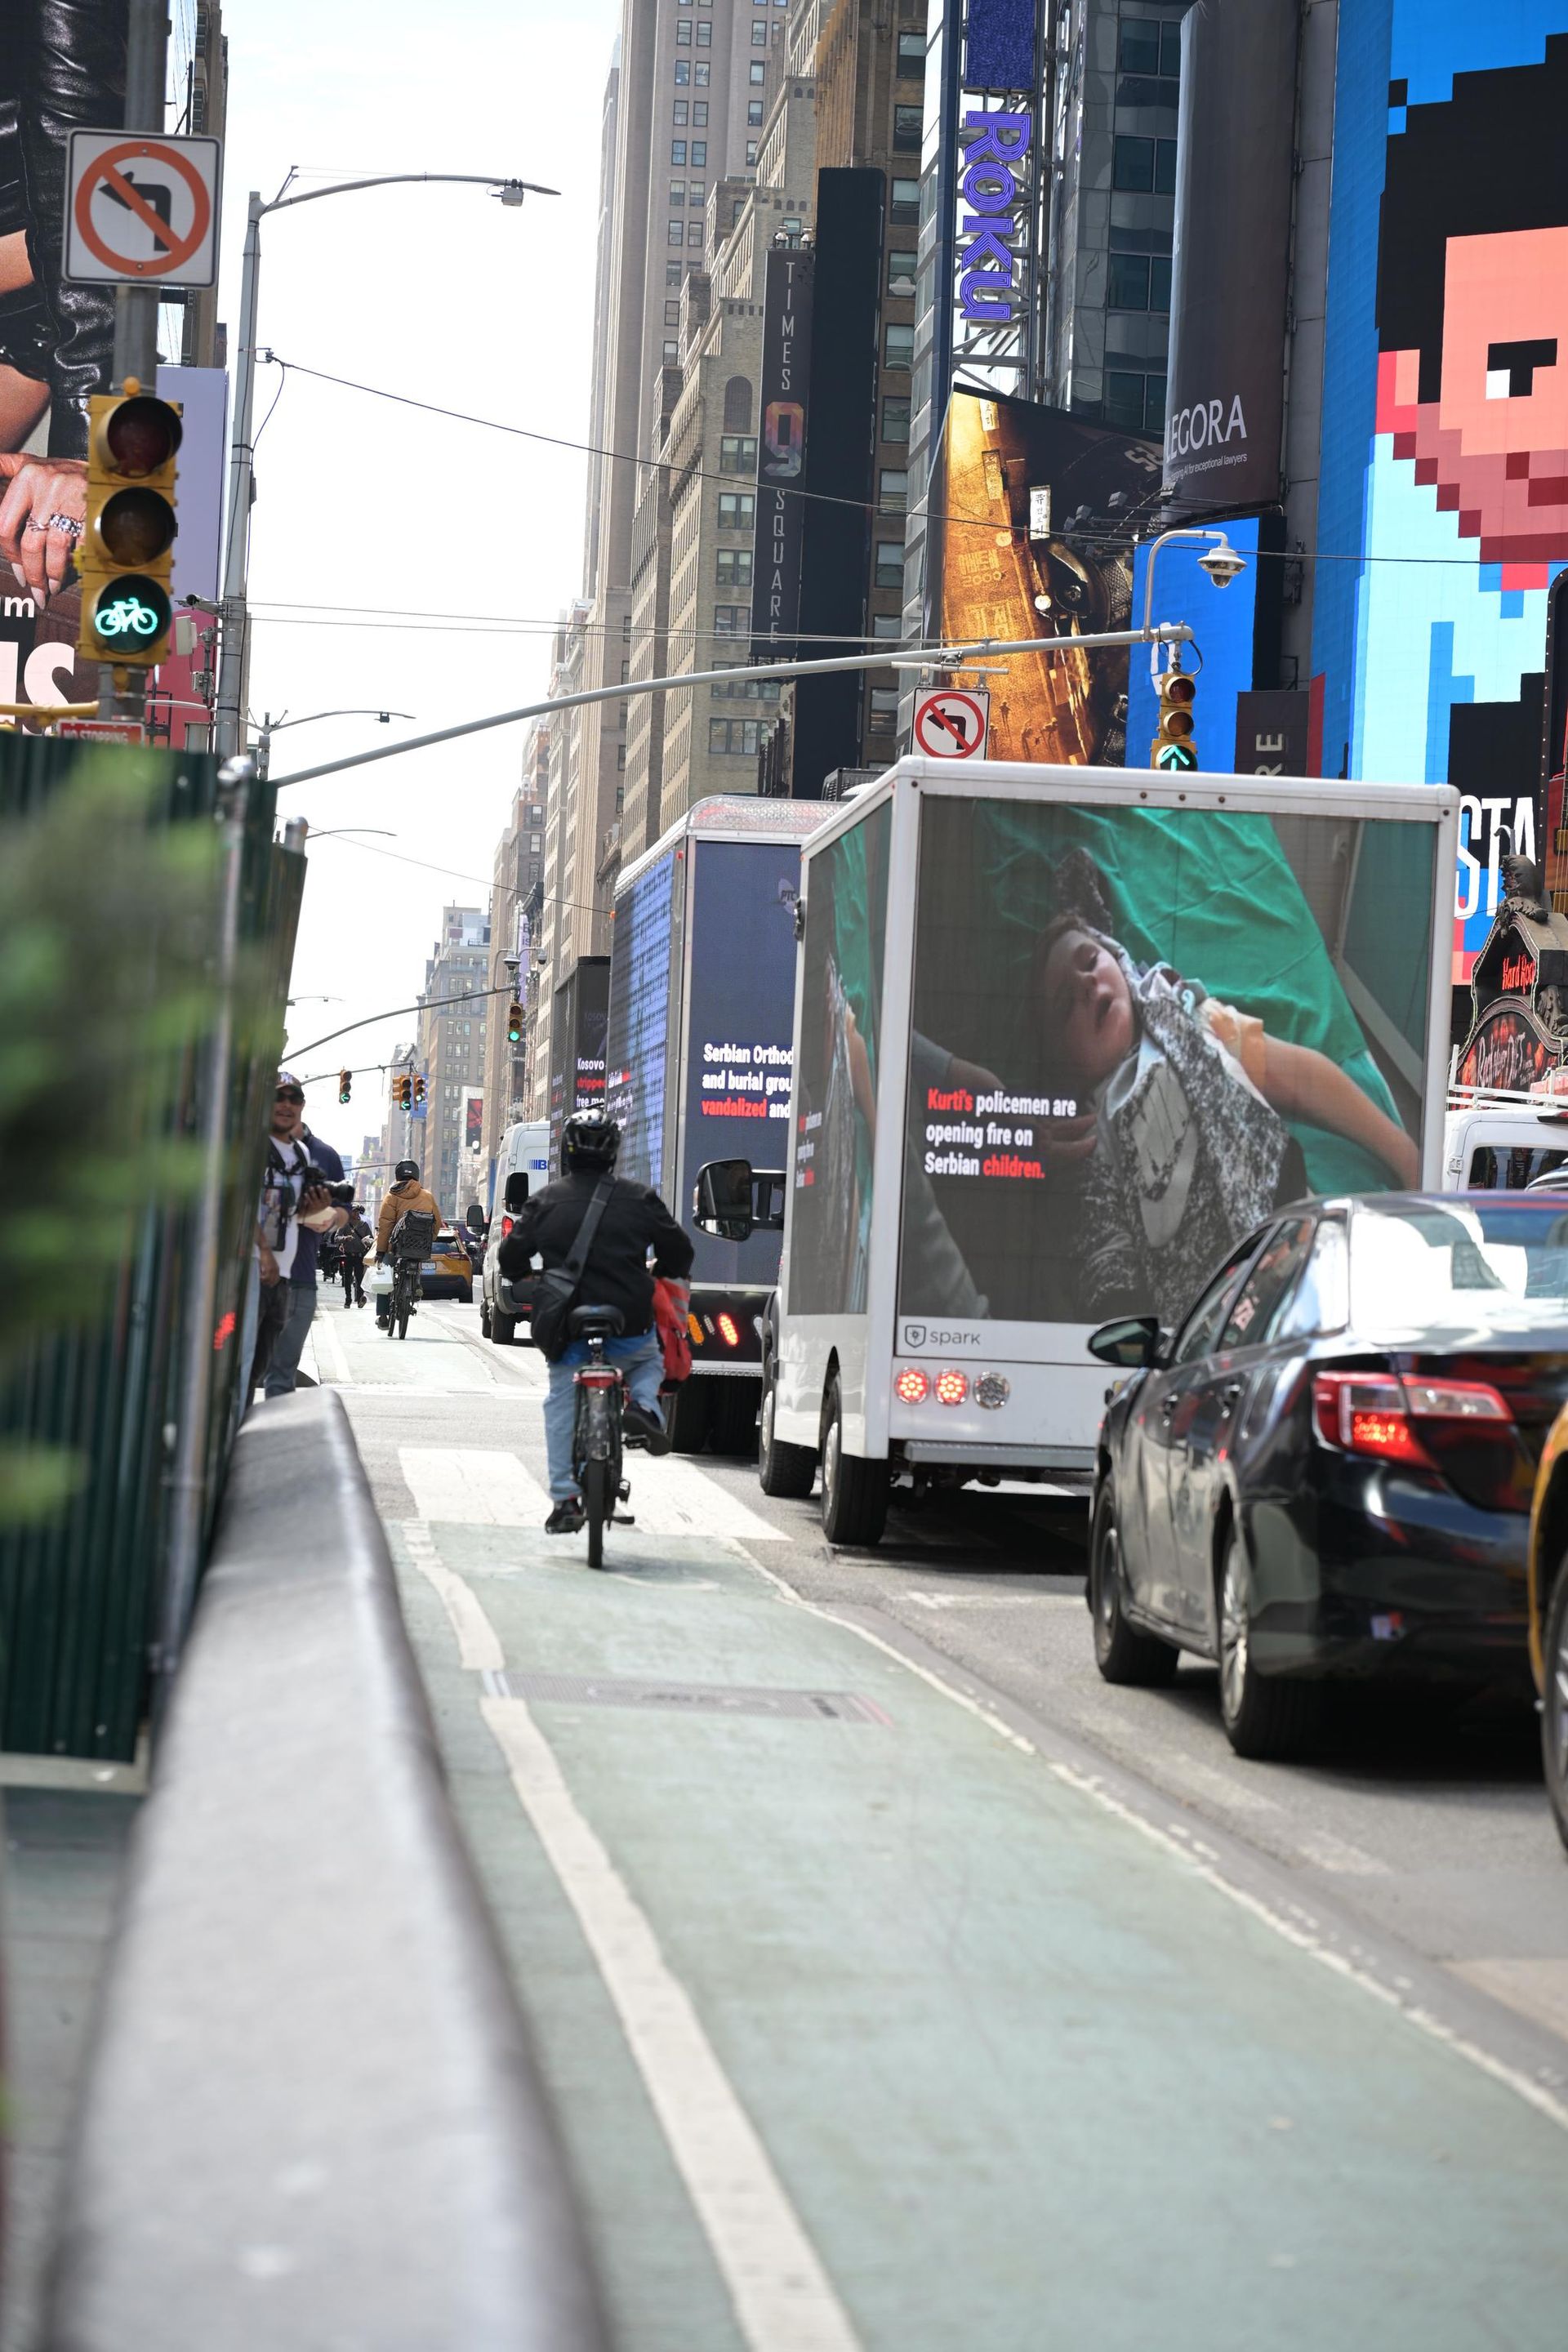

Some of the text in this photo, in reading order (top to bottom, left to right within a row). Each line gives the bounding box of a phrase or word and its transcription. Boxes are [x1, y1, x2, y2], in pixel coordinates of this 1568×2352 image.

[781, 261, 795, 390] TIMES
[1166, 394, 1248, 464] LEGORA
[1195, 455, 1223, 473] exceptional
[1223, 452, 1248, 466] lawyers
[769, 490, 786, 644] SQUARE
[0, 596, 35, 618] m
[1502, 954, 1521, 991] Hard
[577, 1057, 605, 1071] Kosovo
[703, 1043, 751, 1063] Serbian
[702, 1069, 726, 1089] and
[728, 1070, 764, 1091] burial
[576, 1094, 590, 1108] free
[701, 1097, 791, 1119] vandalized and
[928, 1088, 1077, 1117] Kurti's policemen are
[925, 1120, 1034, 1149] opening fire on
[924, 1151, 1046, 1179] Serbian children.
[929, 1330, 981, 1346] spark
